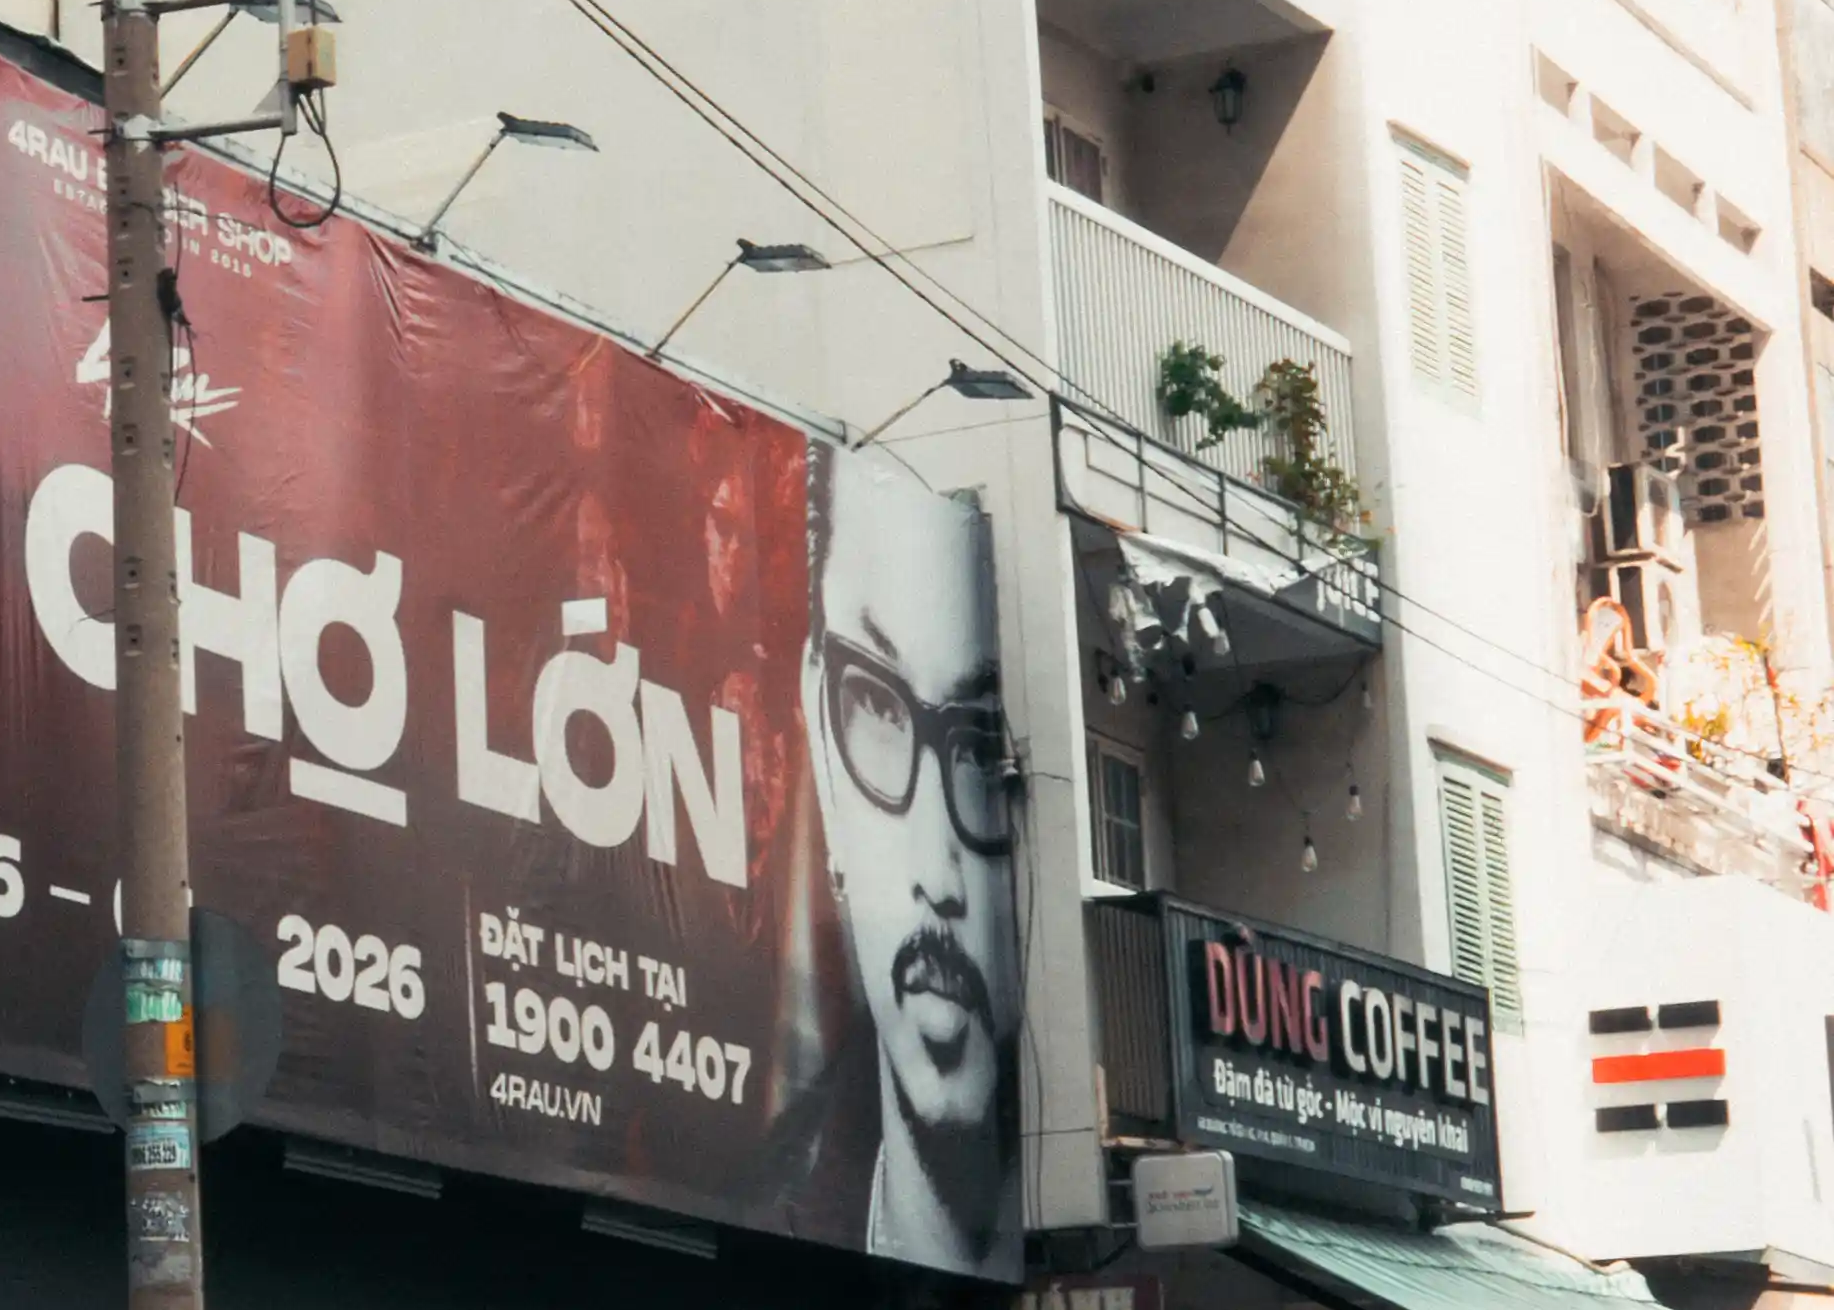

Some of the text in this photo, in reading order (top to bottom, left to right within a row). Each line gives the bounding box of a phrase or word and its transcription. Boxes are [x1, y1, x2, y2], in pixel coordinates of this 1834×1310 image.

[7, 119, 88, 180] 4RAU
[217, 212, 292, 267] SHOP
[24, 462, 408, 828] CHỢ
[452, 598, 749, 889] LỚN
[275, 913, 427, 1021] 2026
[479, 907, 688, 1008] ĐẶT LỊCH TẠI
[485, 981, 753, 1107] 1900 4407
[489, 1071, 602, 1127] 4RAU.VN
[1340, 978, 1489, 1106] COFFEE
[1213, 1057, 1252, 1107] Đậm
[1253, 1066, 1274, 1100] đà
[1275, 1073, 1295, 1111] từ
[1296, 1073, 1324, 1124] gốc
[1335, 1088, 1366, 1136] Mộc
[1366, 1097, 1383, 1141] vị
[1384, 1107, 1436, 1151] nguyên
[1438, 1111, 1469, 1154] khai
